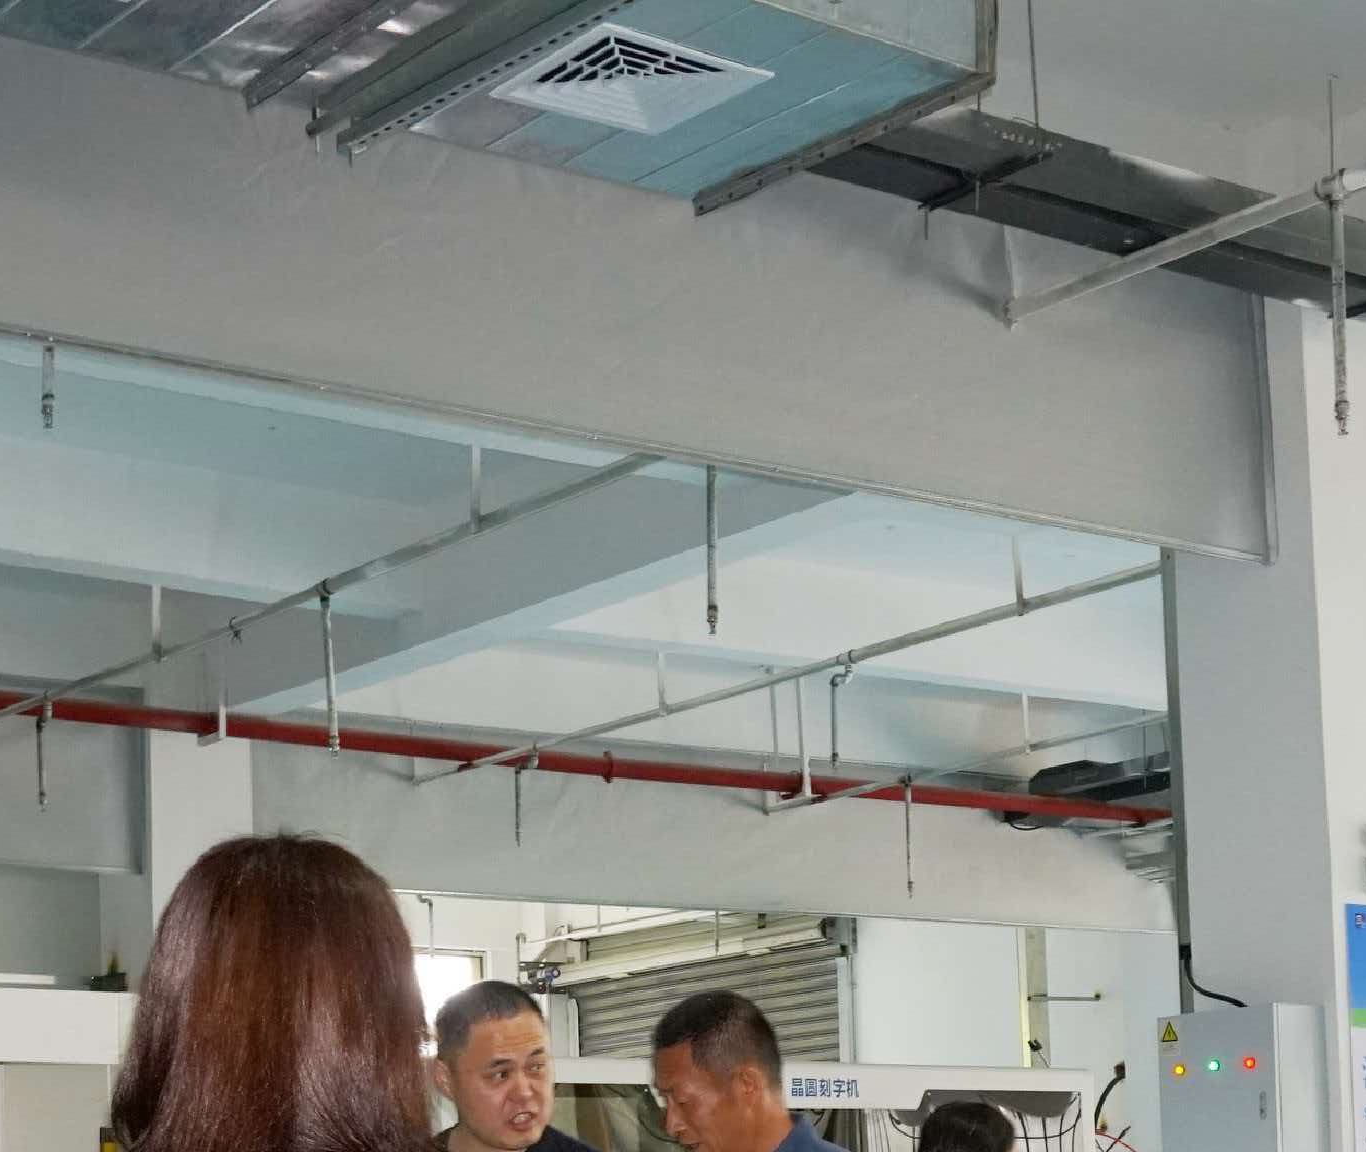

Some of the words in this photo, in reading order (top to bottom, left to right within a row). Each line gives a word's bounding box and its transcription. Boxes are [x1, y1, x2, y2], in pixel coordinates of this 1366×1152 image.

[791, 1078, 859, 1098] 晶圆刻字机
